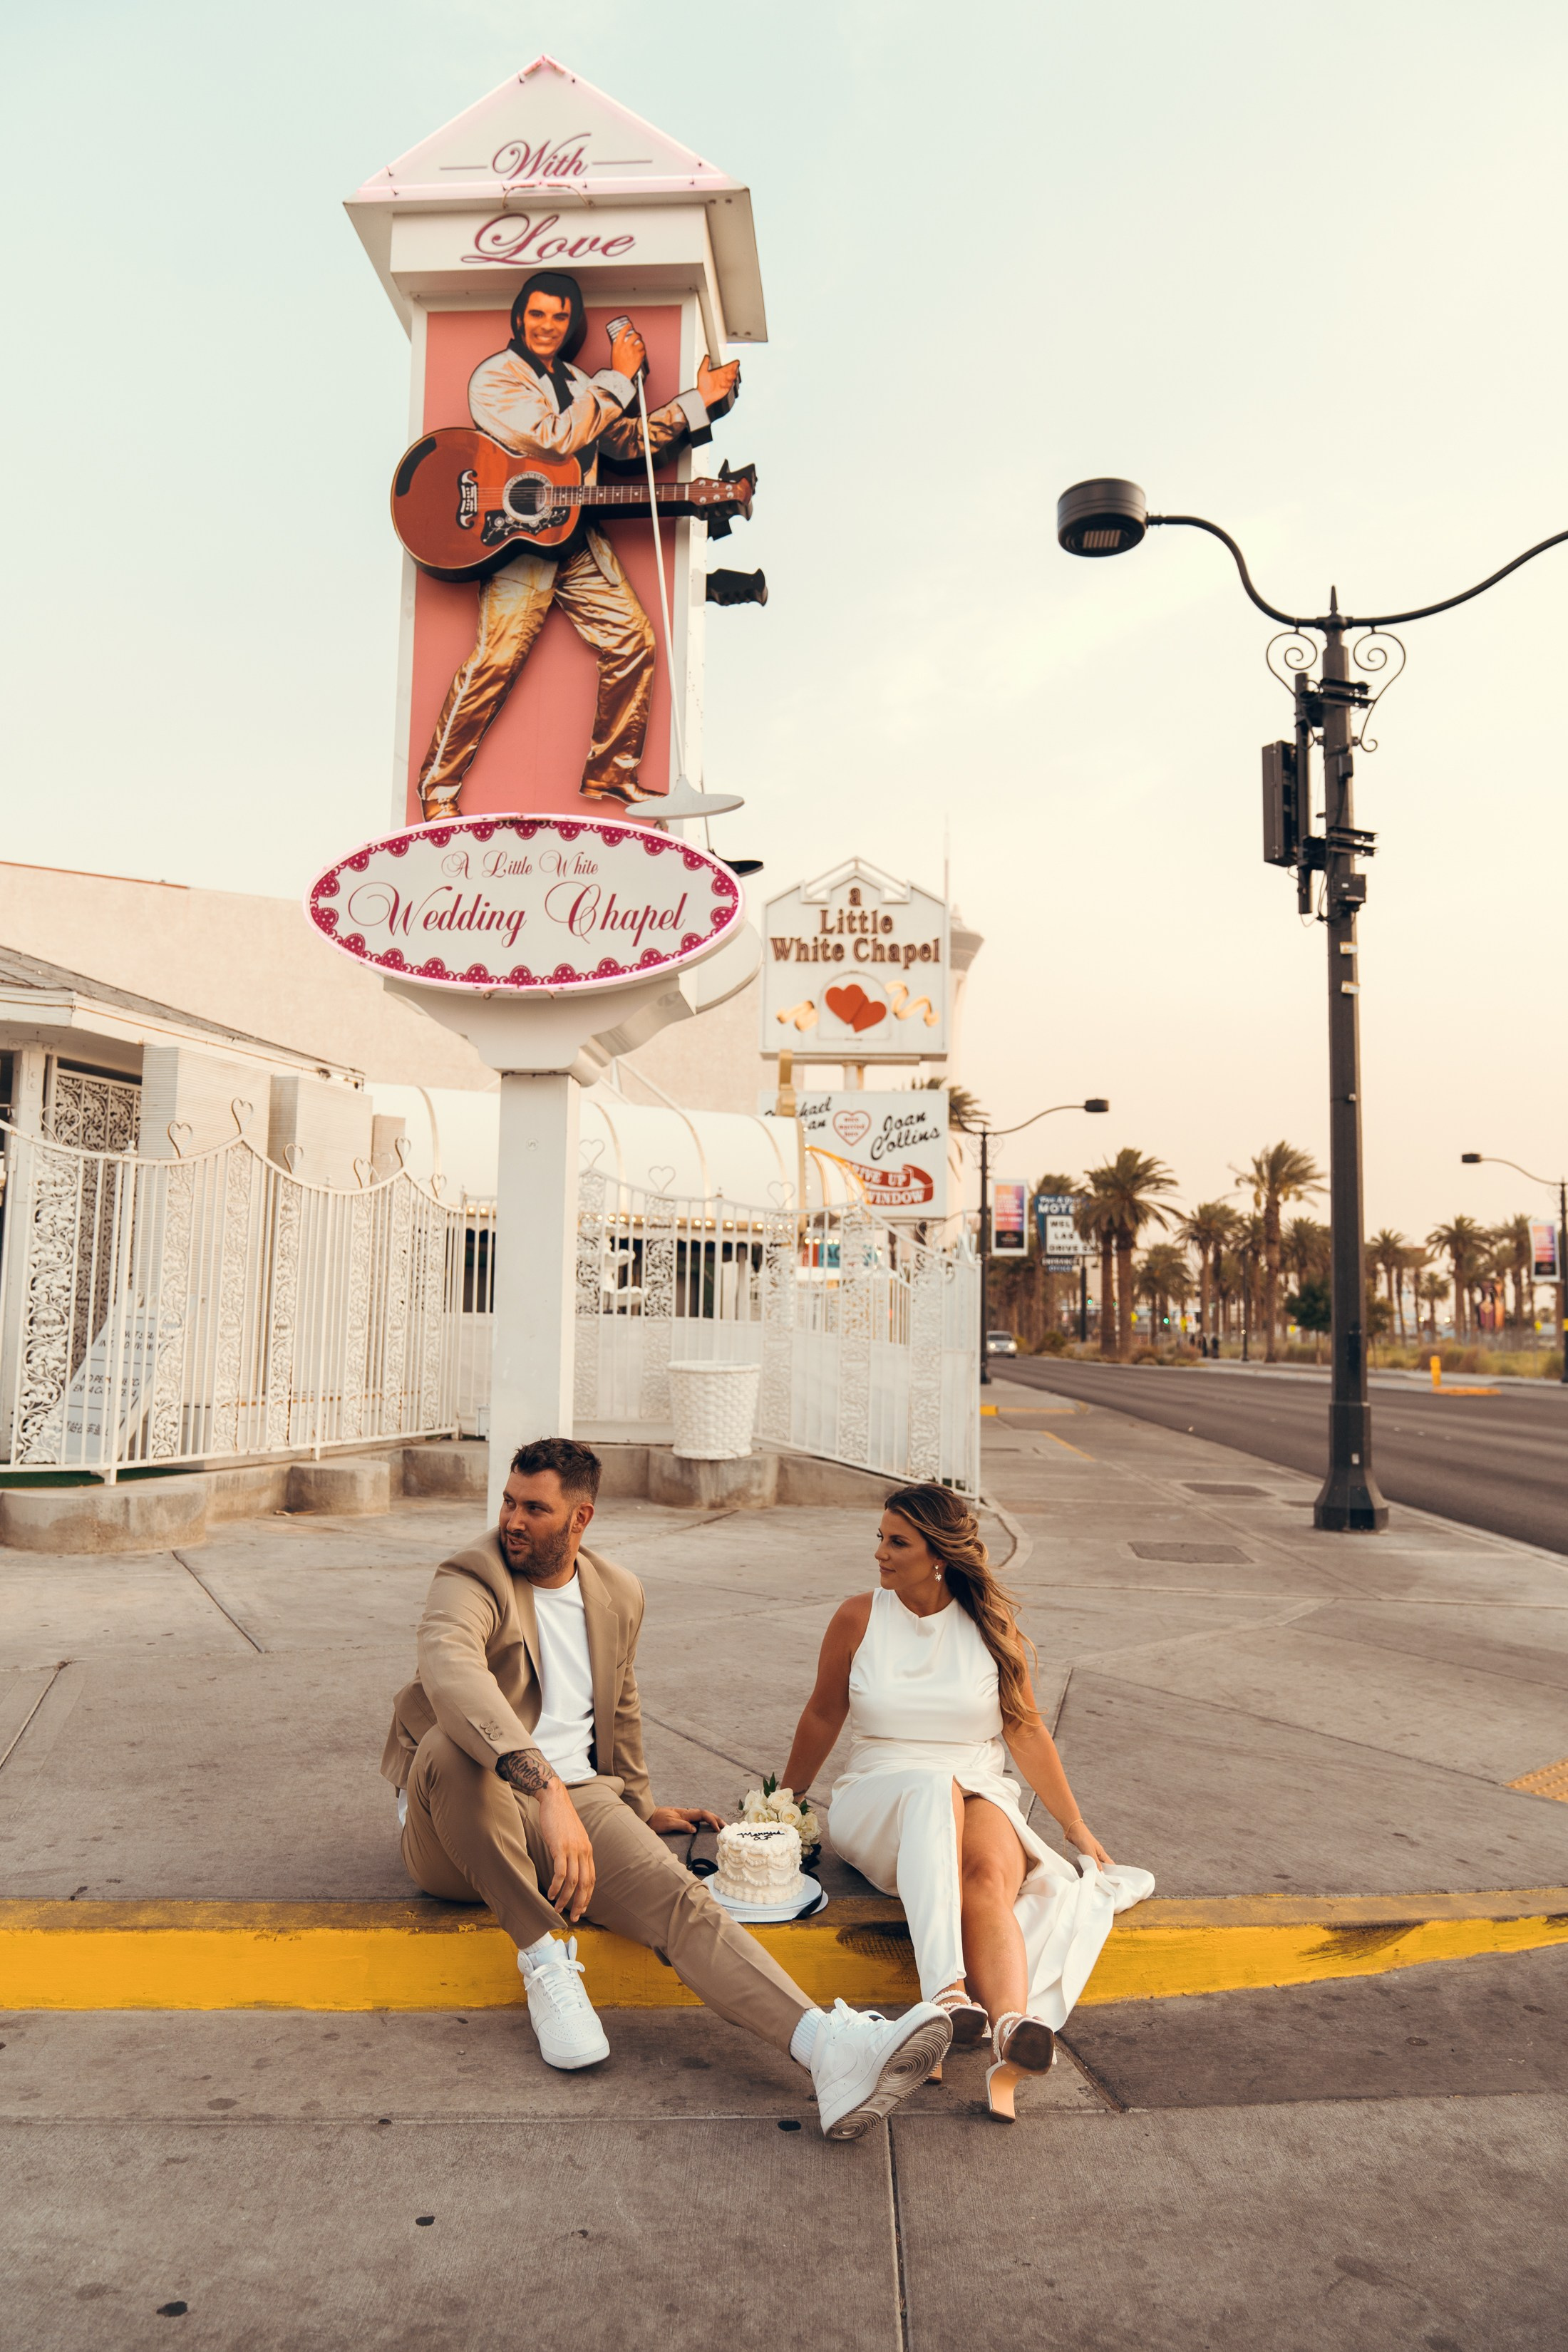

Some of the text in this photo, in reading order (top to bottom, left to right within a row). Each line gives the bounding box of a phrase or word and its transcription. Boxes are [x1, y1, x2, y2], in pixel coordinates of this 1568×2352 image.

[492, 133, 591, 180] With
[460, 212, 636, 265] Love
[441, 850, 599, 880] A Little White
[849, 887, 862, 907] a
[348, 881, 689, 949] Wedding Chapel
[820, 909, 894, 934] Little
[770, 937, 940, 970] White Chapel
[883, 1111, 927, 1141] Joan
[870, 1127, 941, 1161] Collins
[888, 1173, 907, 1187] UP
[1038, 1202, 1076, 1214] MOTE
